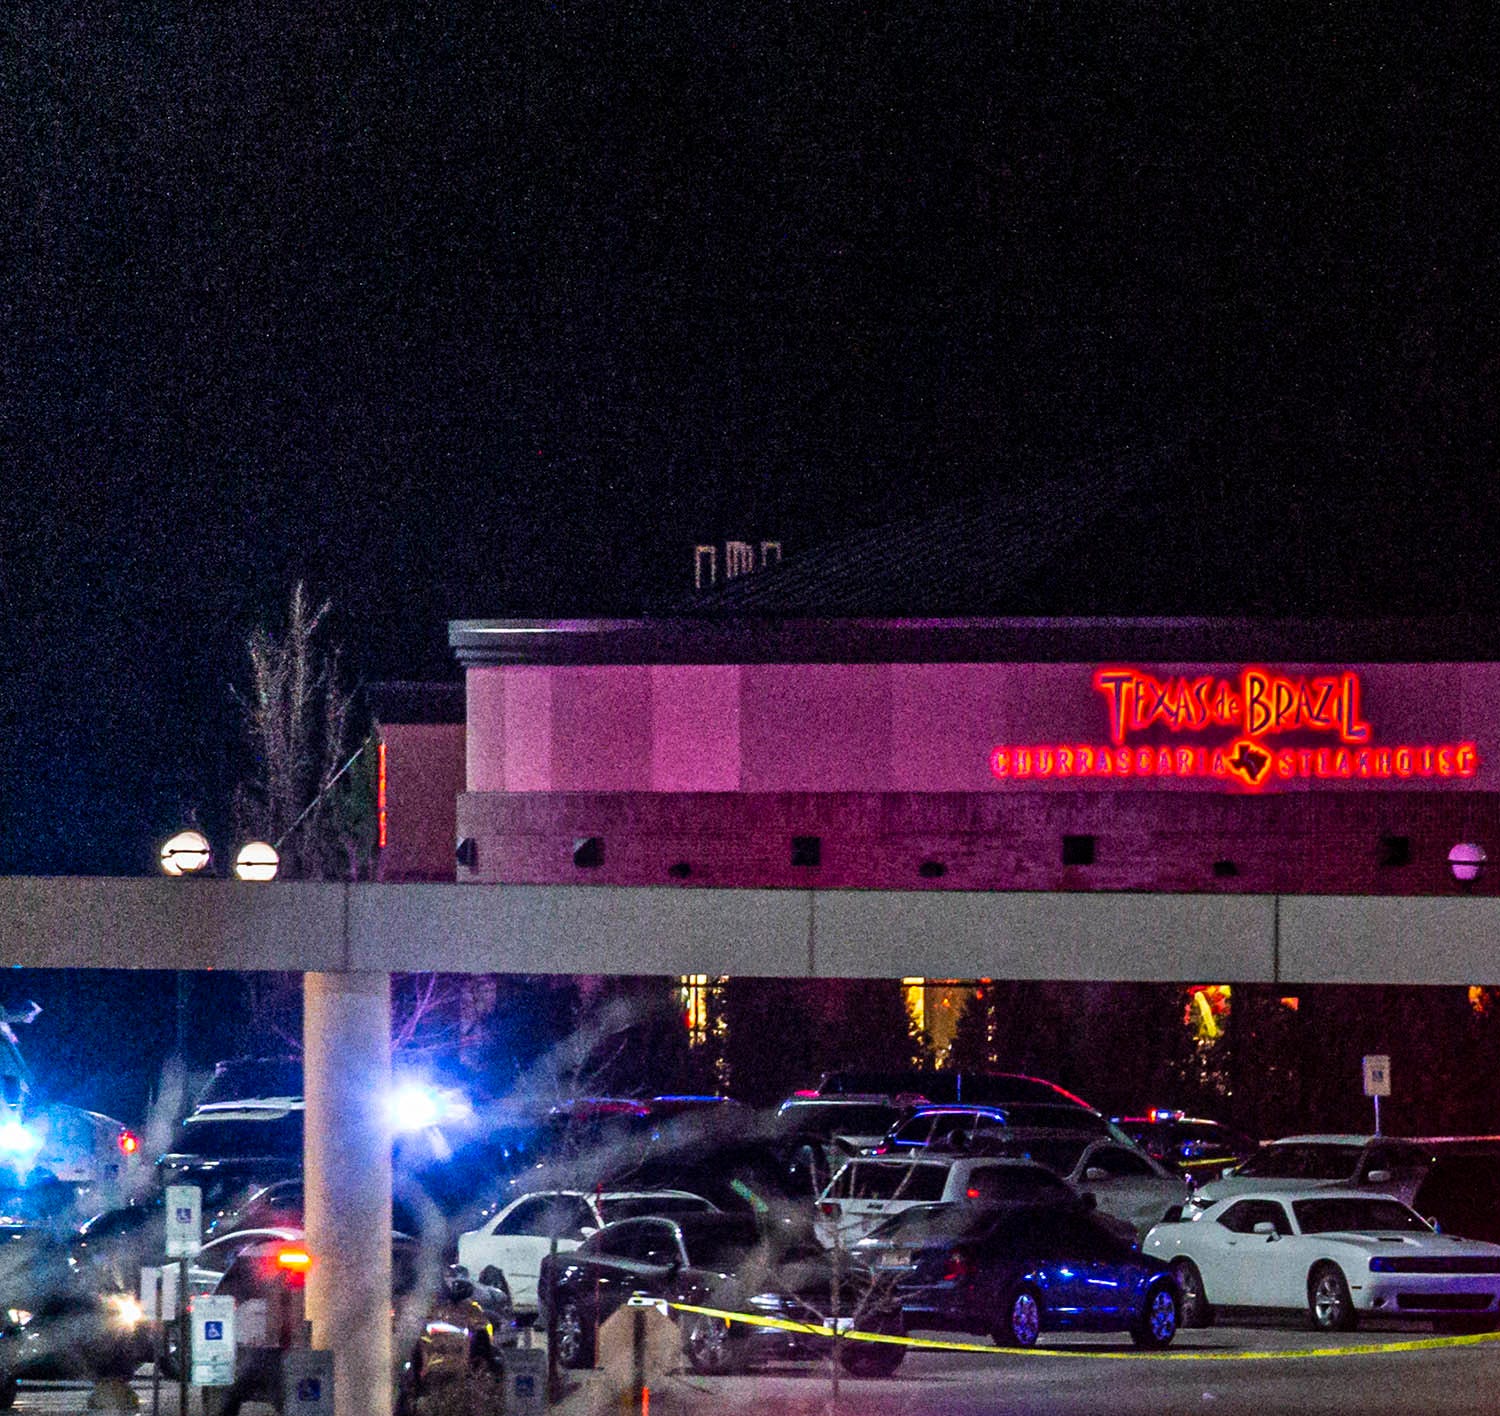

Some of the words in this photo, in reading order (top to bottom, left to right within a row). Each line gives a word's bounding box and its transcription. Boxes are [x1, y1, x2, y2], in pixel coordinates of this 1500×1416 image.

[1097, 668, 1209, 743] TEXAS
[1215, 682, 1240, 718] de
[1242, 668, 1369, 741] BRAZIL
[991, 744, 1225, 779] CHURRASCARIA
[1276, 743, 1477, 778] STEAKHOUSE
